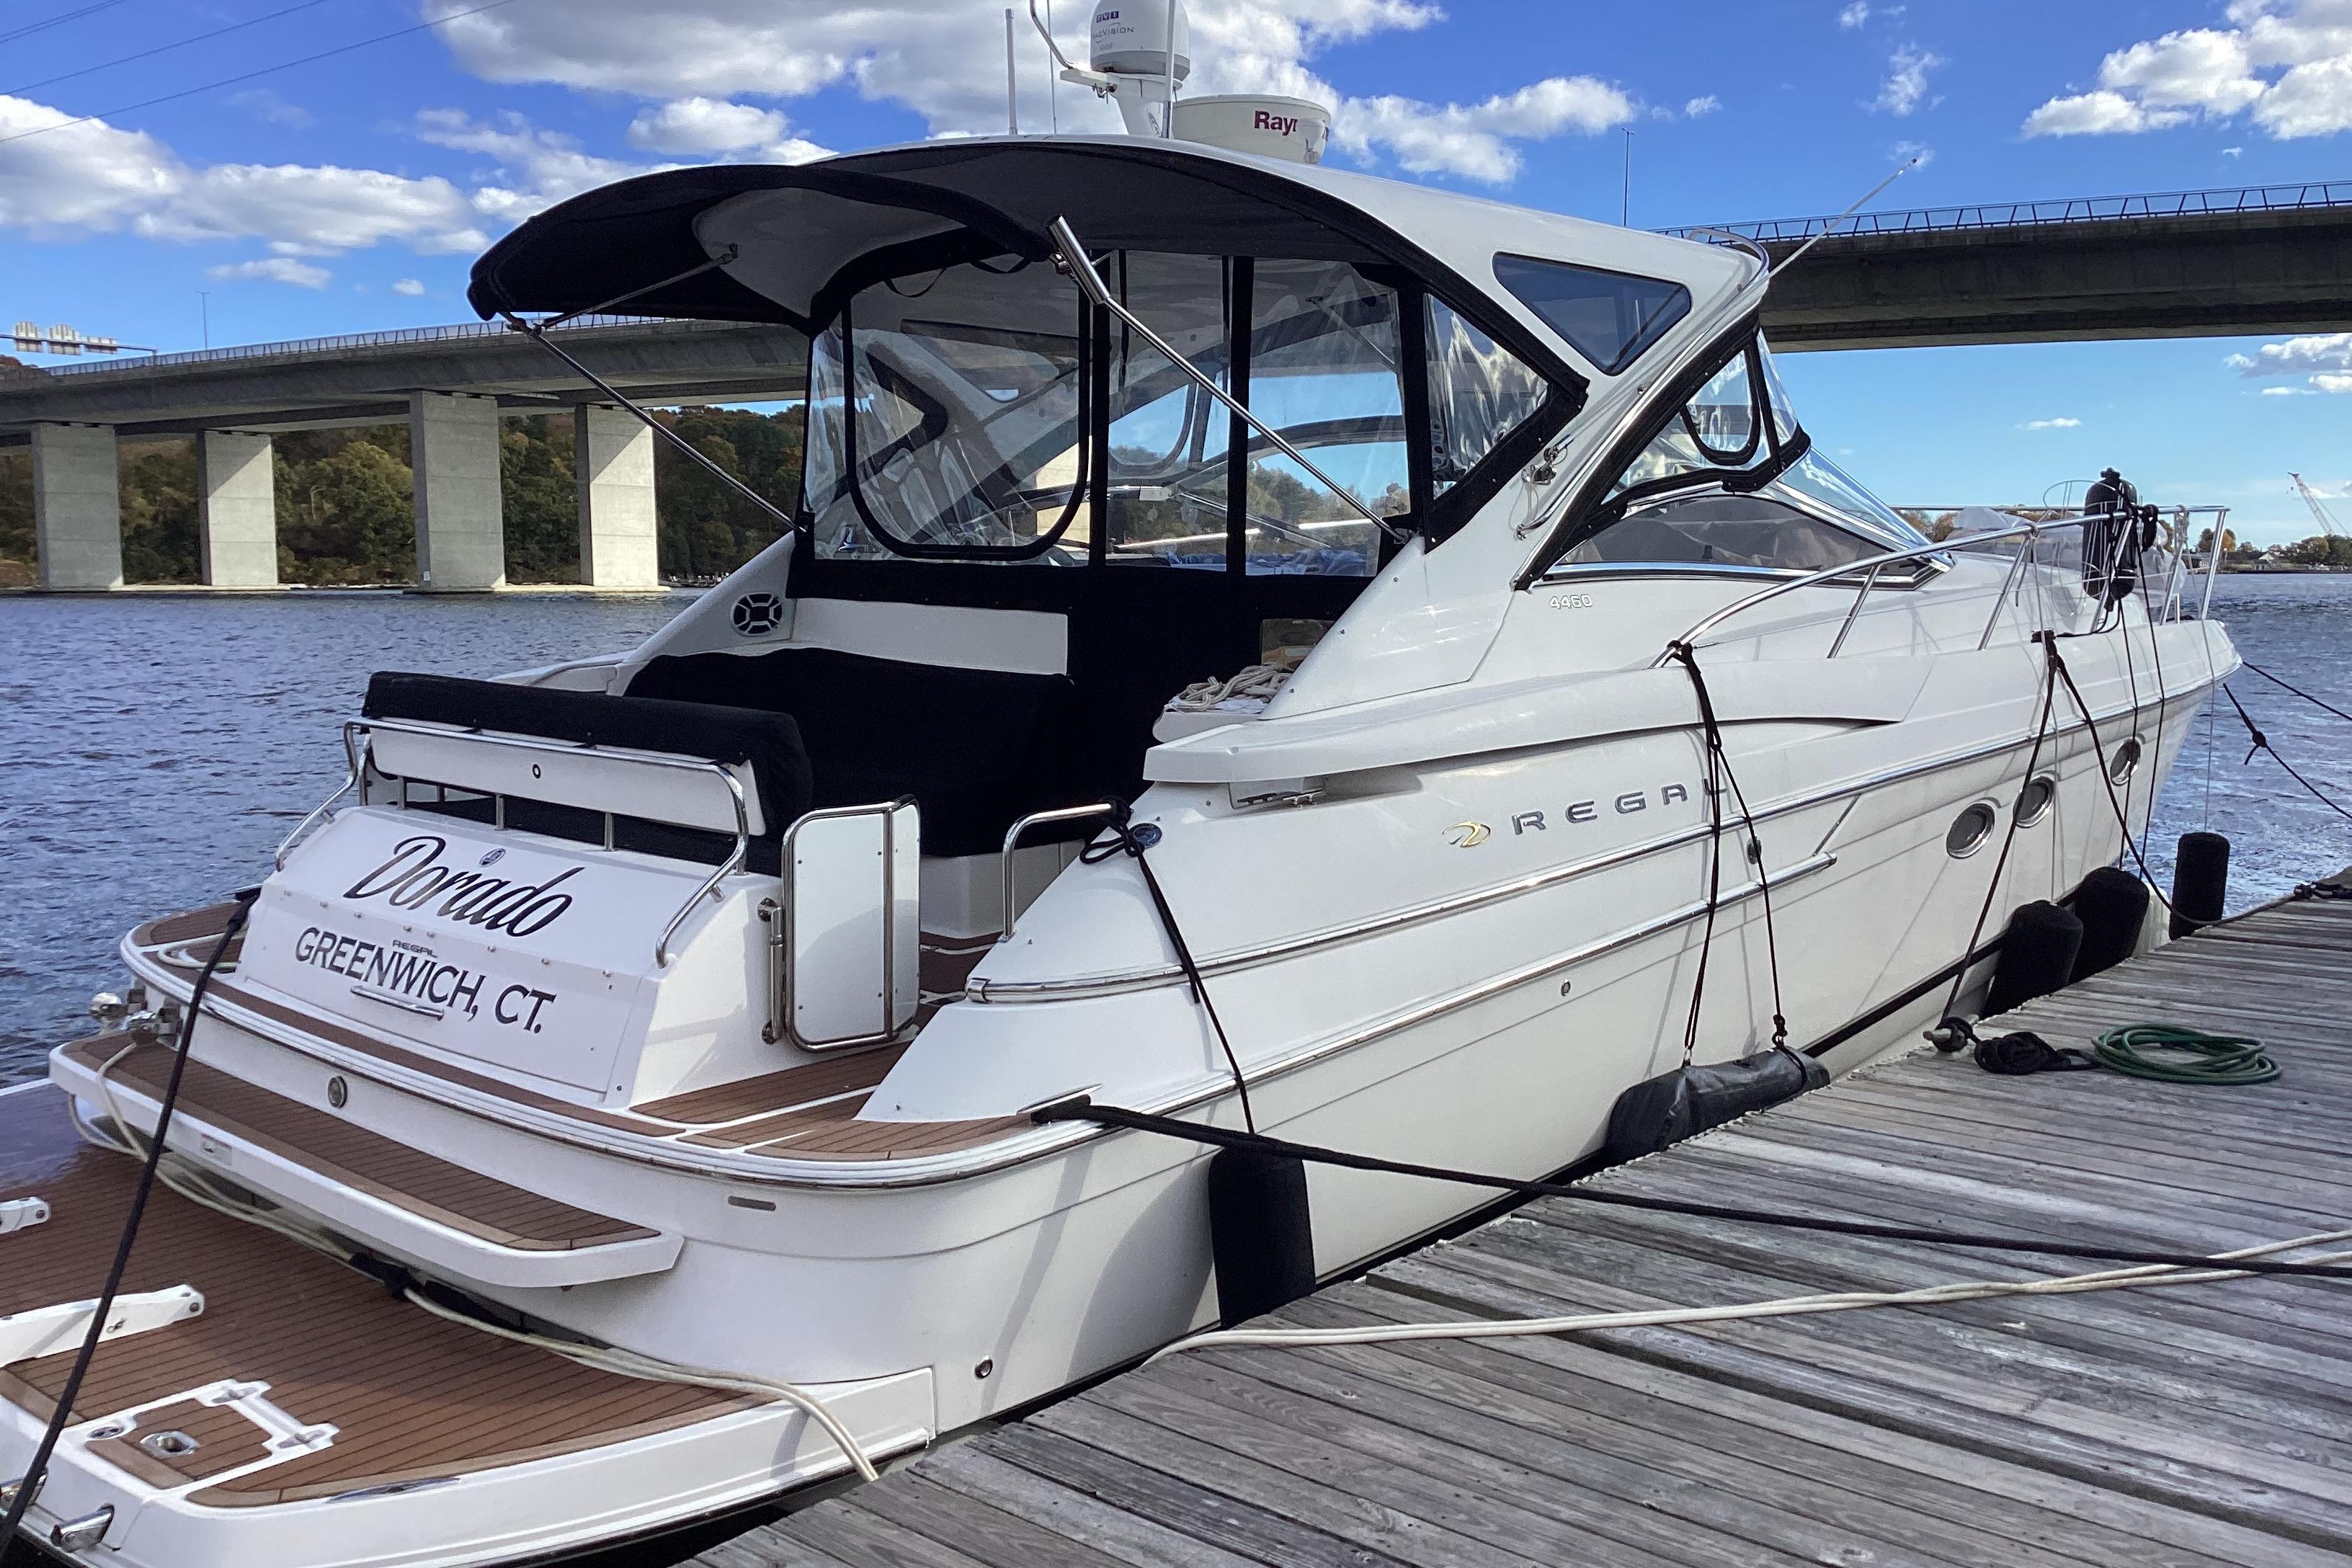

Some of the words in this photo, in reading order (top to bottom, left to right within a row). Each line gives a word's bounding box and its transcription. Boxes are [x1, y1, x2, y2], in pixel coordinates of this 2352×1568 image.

[1550, 594, 1592, 610] 4460
[343, 836, 585, 937] Dorado
[393, 940, 438, 958] REGAL
[295, 927, 486, 1022] GREENWICH,
[494, 984, 558, 1034] CT.
